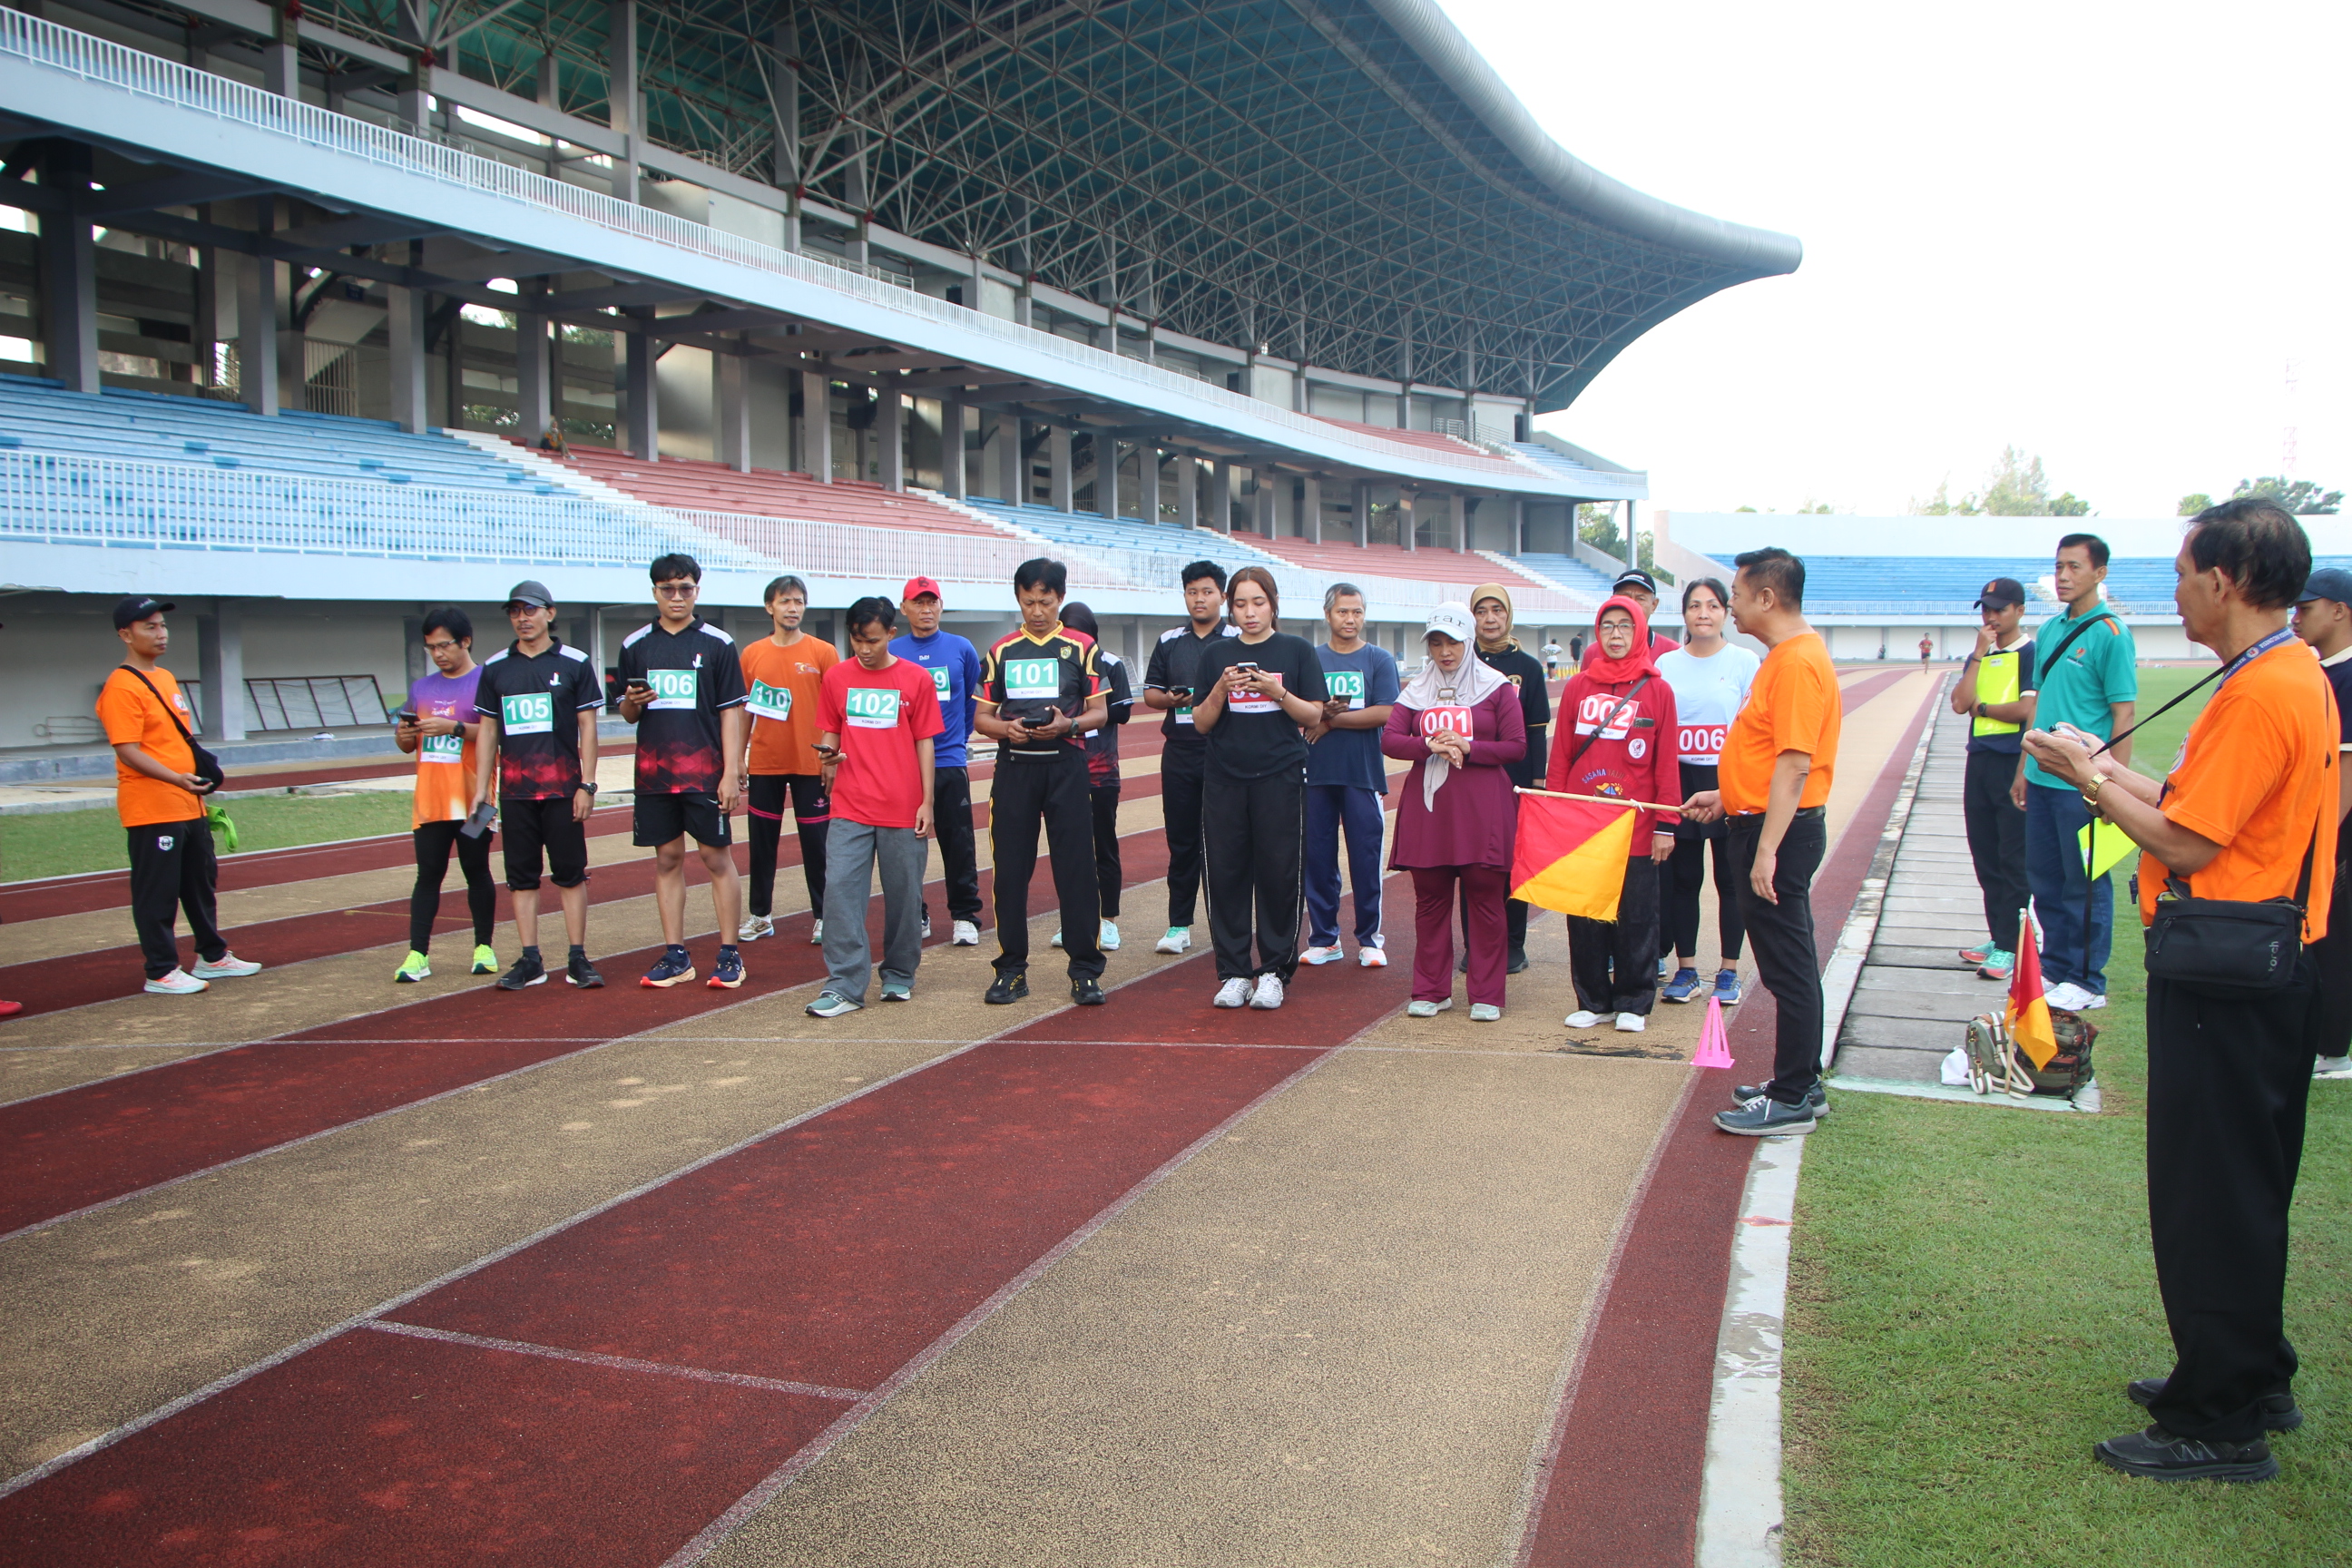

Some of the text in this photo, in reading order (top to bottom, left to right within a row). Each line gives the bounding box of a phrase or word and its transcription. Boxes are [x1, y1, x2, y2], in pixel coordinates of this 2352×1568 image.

[1011, 662, 1054, 684] 101
[652, 674, 693, 695] 106
[1326, 675, 1361, 696] 103
[756, 686, 788, 708] 110
[851, 692, 897, 715] 102
[506, 697, 549, 721] 105
[1583, 697, 1632, 727] 002
[1424, 710, 1467, 734] 001
[426, 733, 460, 751] 108
[1679, 728, 1725, 751] 006
[1582, 769, 1606, 784] SASANA
[2268, 941, 2278, 971] torch
